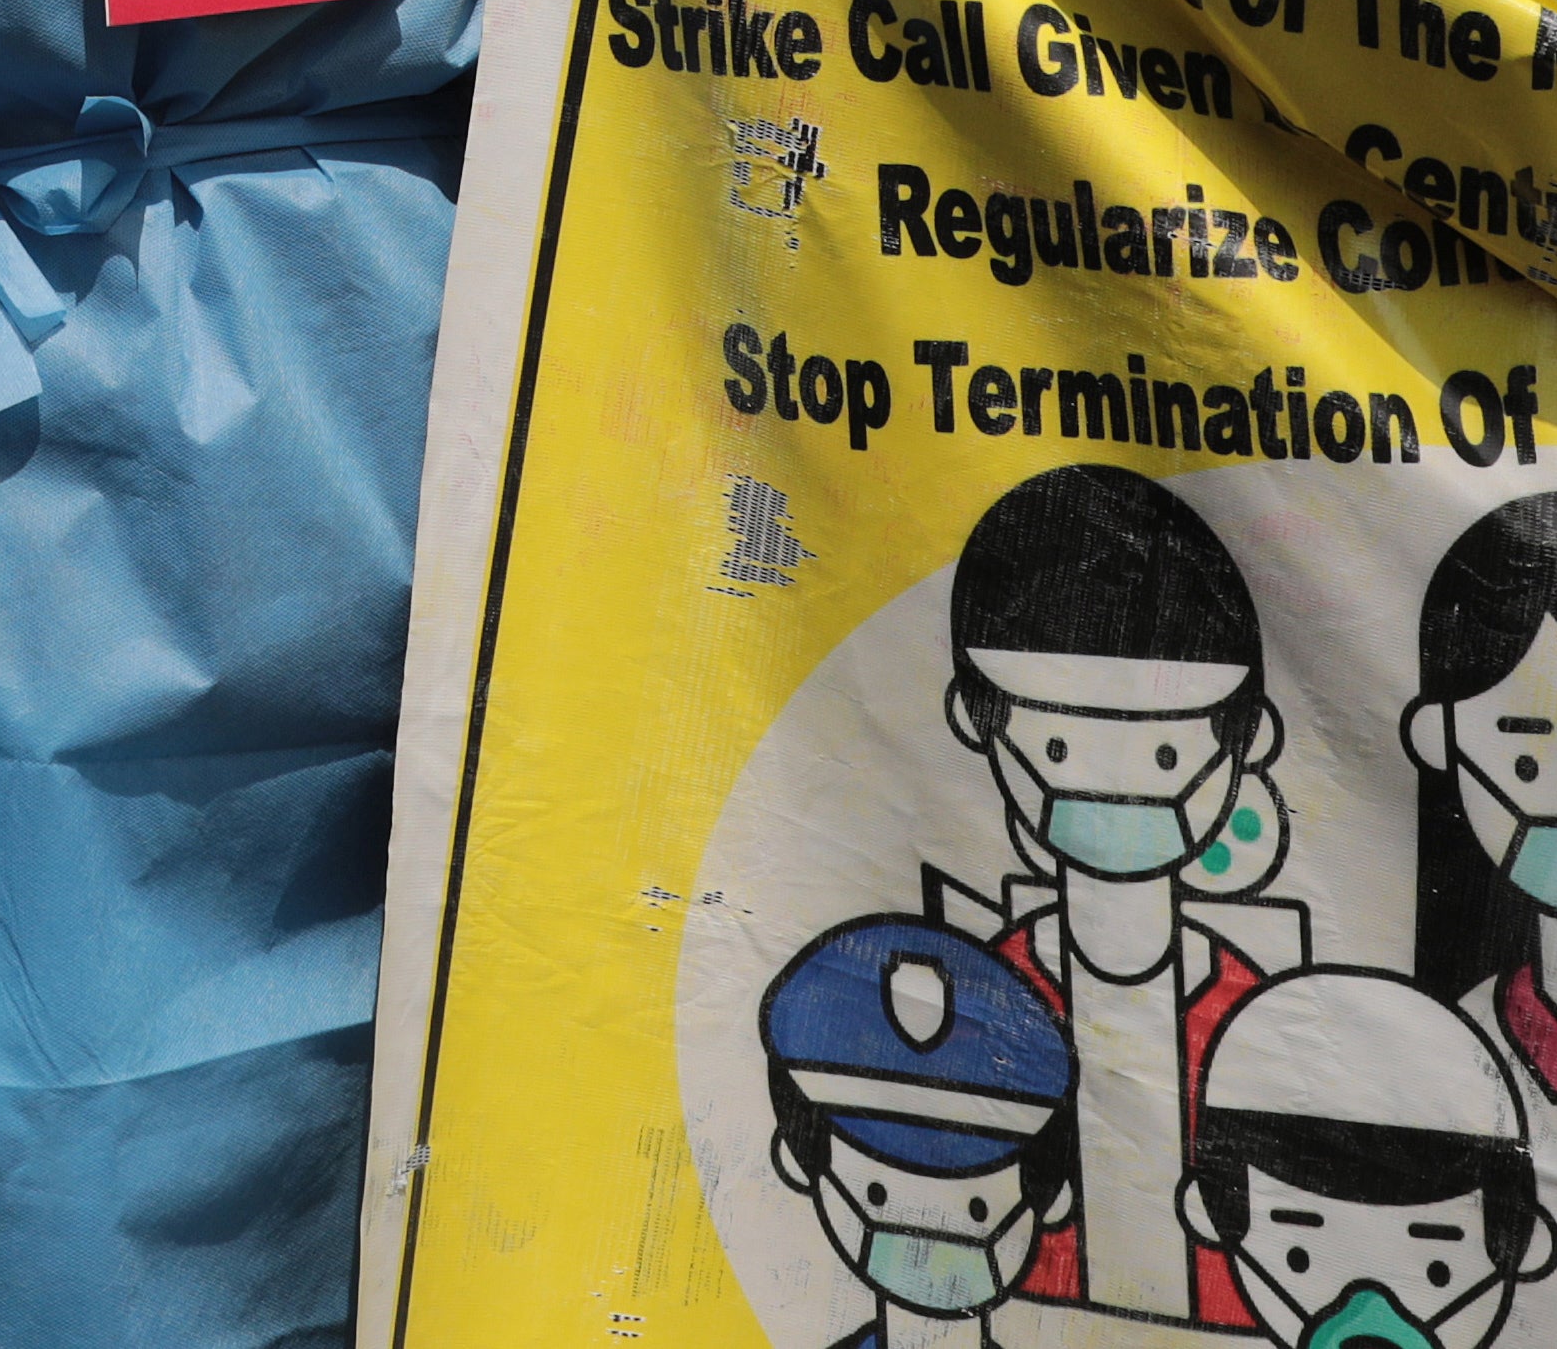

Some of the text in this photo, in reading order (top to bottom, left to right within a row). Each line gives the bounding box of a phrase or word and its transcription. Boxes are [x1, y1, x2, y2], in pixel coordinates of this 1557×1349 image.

[1016, 3, 1233, 118] Given
[877, 162, 1301, 287] Regularize
[720, 321, 892, 452] Stop
[912, 337, 1422, 466] Termination
[1439, 364, 1538, 468] Of
